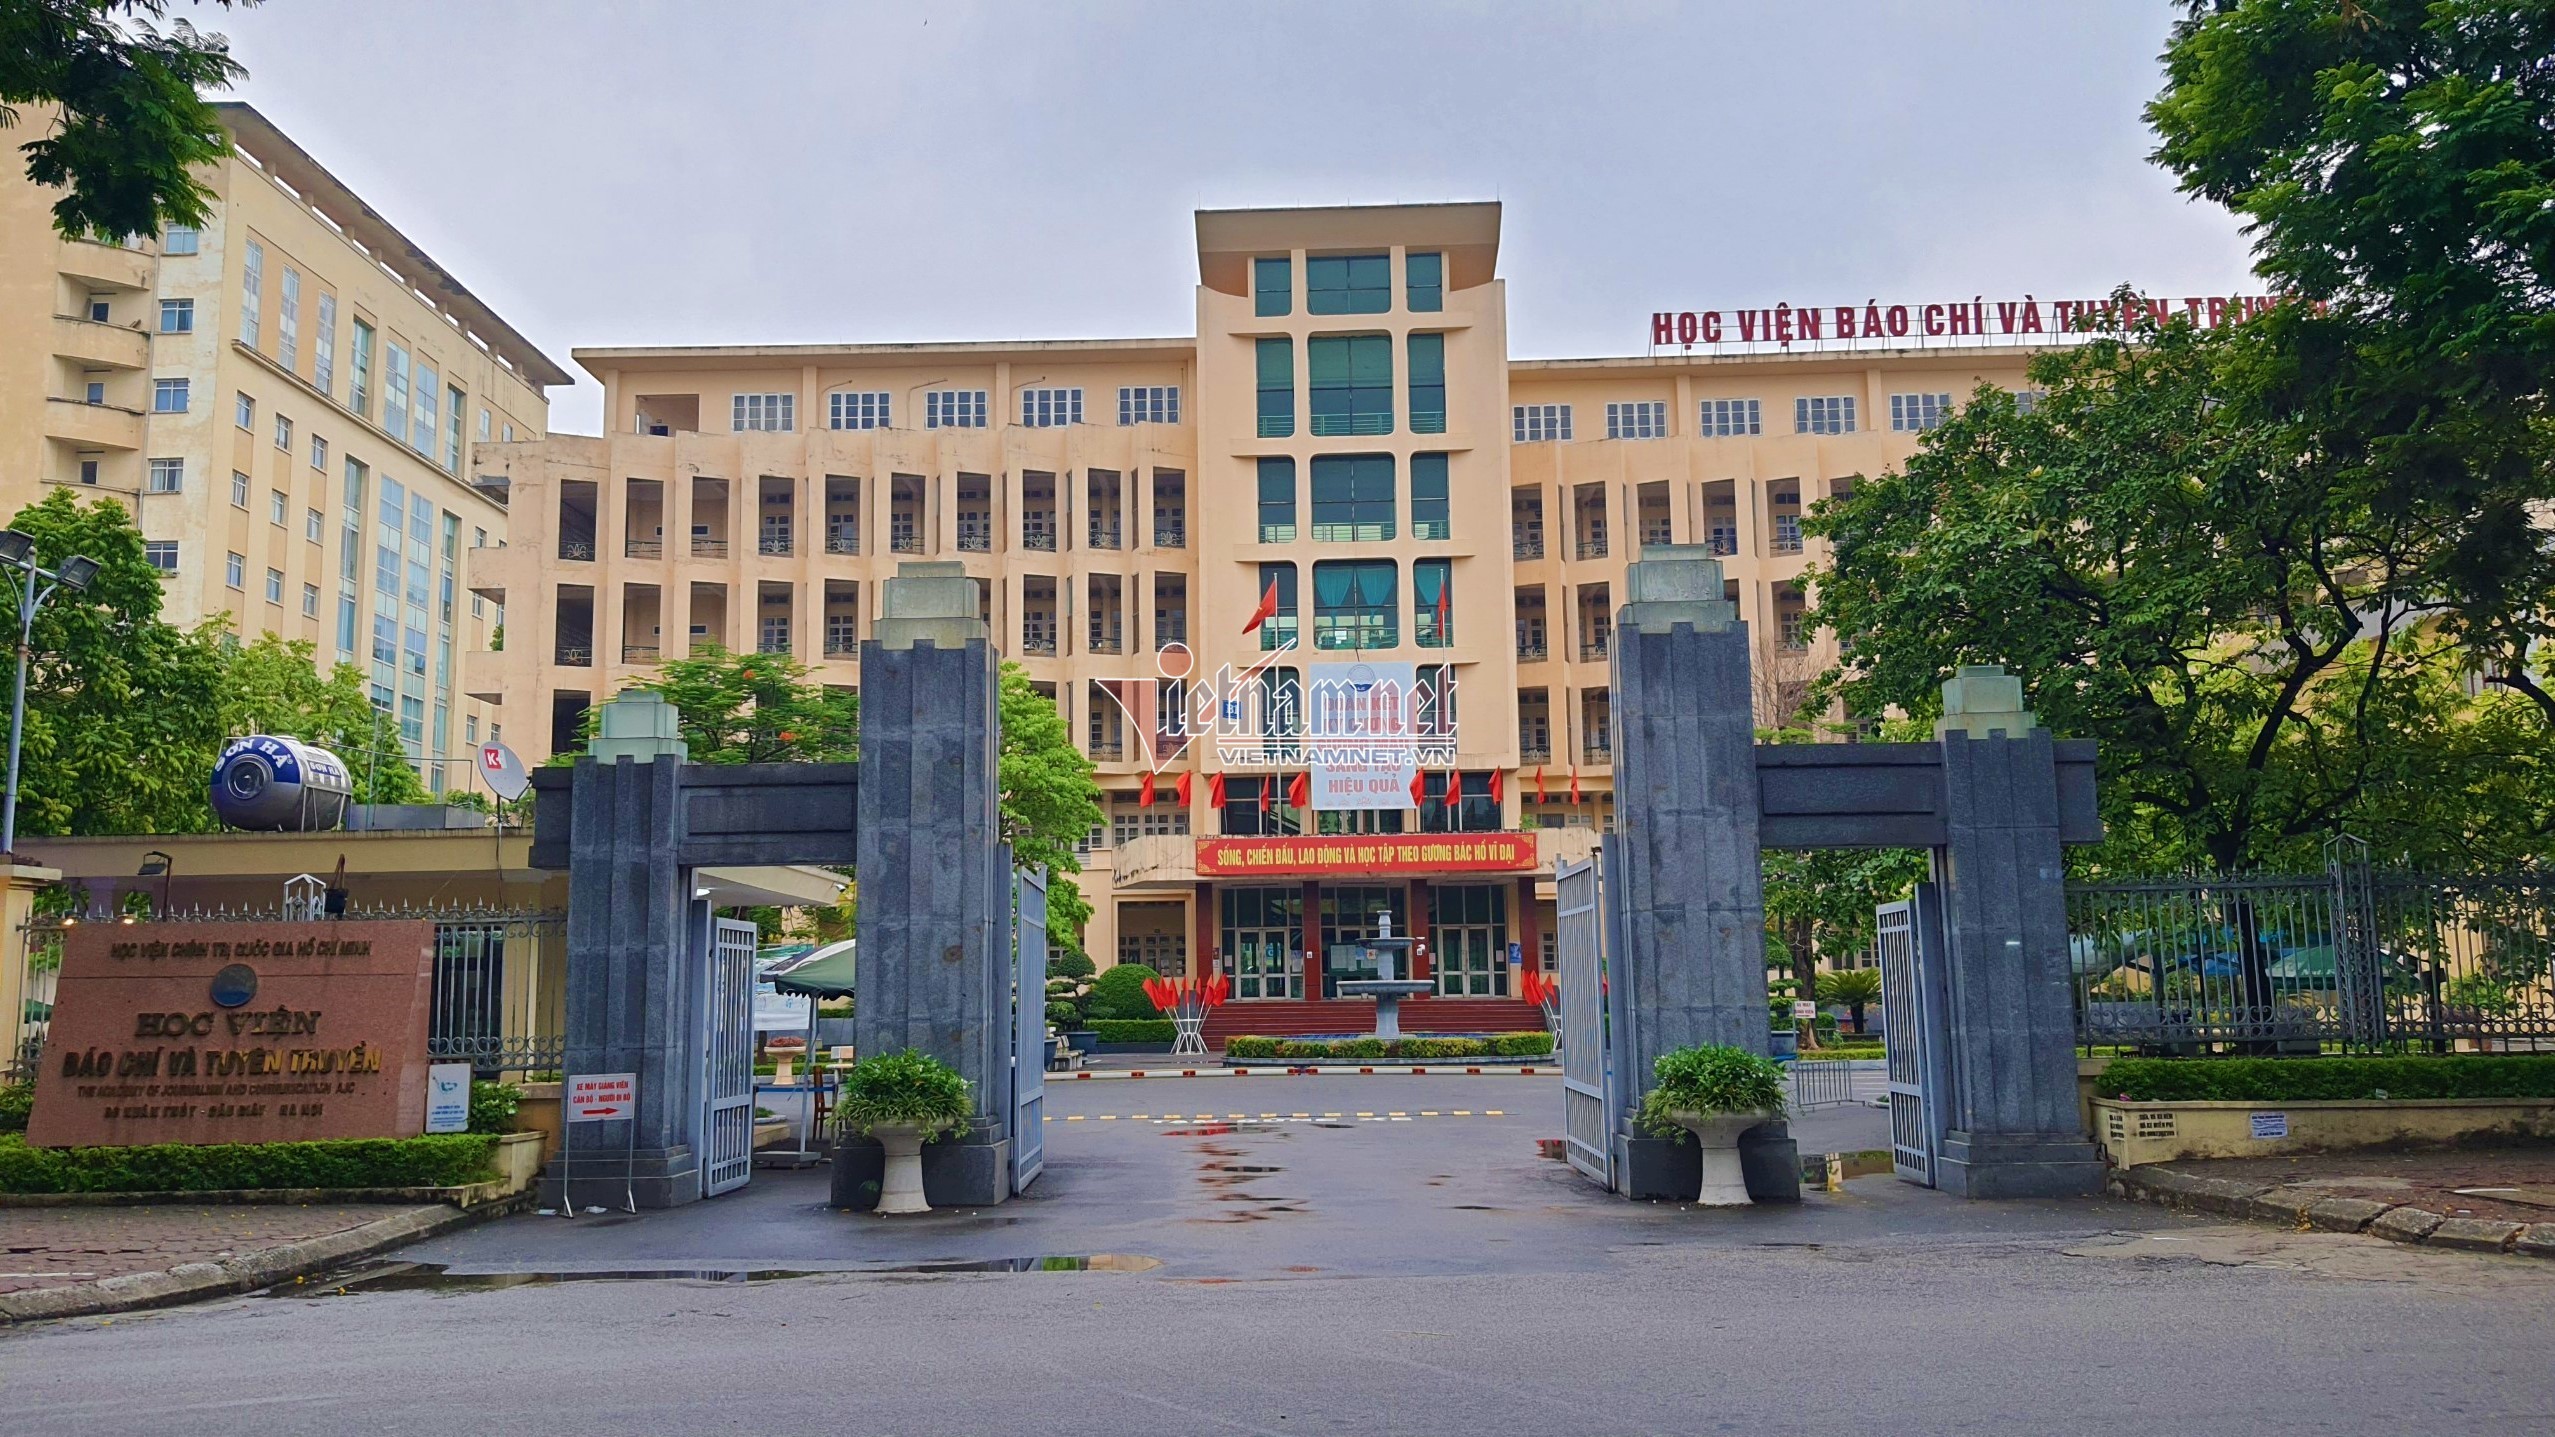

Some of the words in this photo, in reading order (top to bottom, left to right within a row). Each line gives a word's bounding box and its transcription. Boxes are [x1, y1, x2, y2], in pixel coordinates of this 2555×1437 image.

[1653, 311, 1722, 350] HỌC
[1737, 302, 1820, 347] VIỆN
[1835, 299, 1908, 338] BÁO
[1925, 296, 1983, 335] CHÍ
[1997, 295, 2043, 334] VÀ
[1328, 776, 1364, 796] HIỆU
[1368, 773, 1400, 794] QUẢ
[1217, 843, 1245, 867] SỐNG,
[1247, 842, 1274, 865] CHIẾN
[1275, 842, 1297, 867] ĐẤU,
[1298, 847, 1315, 864] LAO
[1317, 844, 1342, 868] ĐỘNG
[1344, 843, 1356, 864] VÀ
[1358, 846, 1375, 867] HỌC
[1378, 842, 1395, 867] TẬP
[1397, 845, 1419, 863] THEO
[1421, 843, 1452, 862] GƯƠNG
[1454, 841, 1472, 862] BÁC
[1488, 841, 1498, 861] VĨ
[1499, 843, 1515, 865] ĐẠI
[110, 942, 137, 960] HỌC
[141, 939, 169, 961] VIỆN
[235, 938, 270, 957] QUỐC
[272, 941, 294, 956] GIA
[134, 1012, 215, 1041] HỌC
[226, 1005, 322, 1042] VIỆN
[62, 1046, 113, 1077] BÁO
[118, 1046, 165, 1077] CHÍ
[168, 1046, 197, 1077] VÀ
[206, 1047, 283, 1076] TUYÊN
[290, 1041, 382, 1074] TRUYỀN
[78, 1085, 97, 1097] THE
[146, 1085, 160, 1097] OF
[225, 1083, 248, 1095] AND
